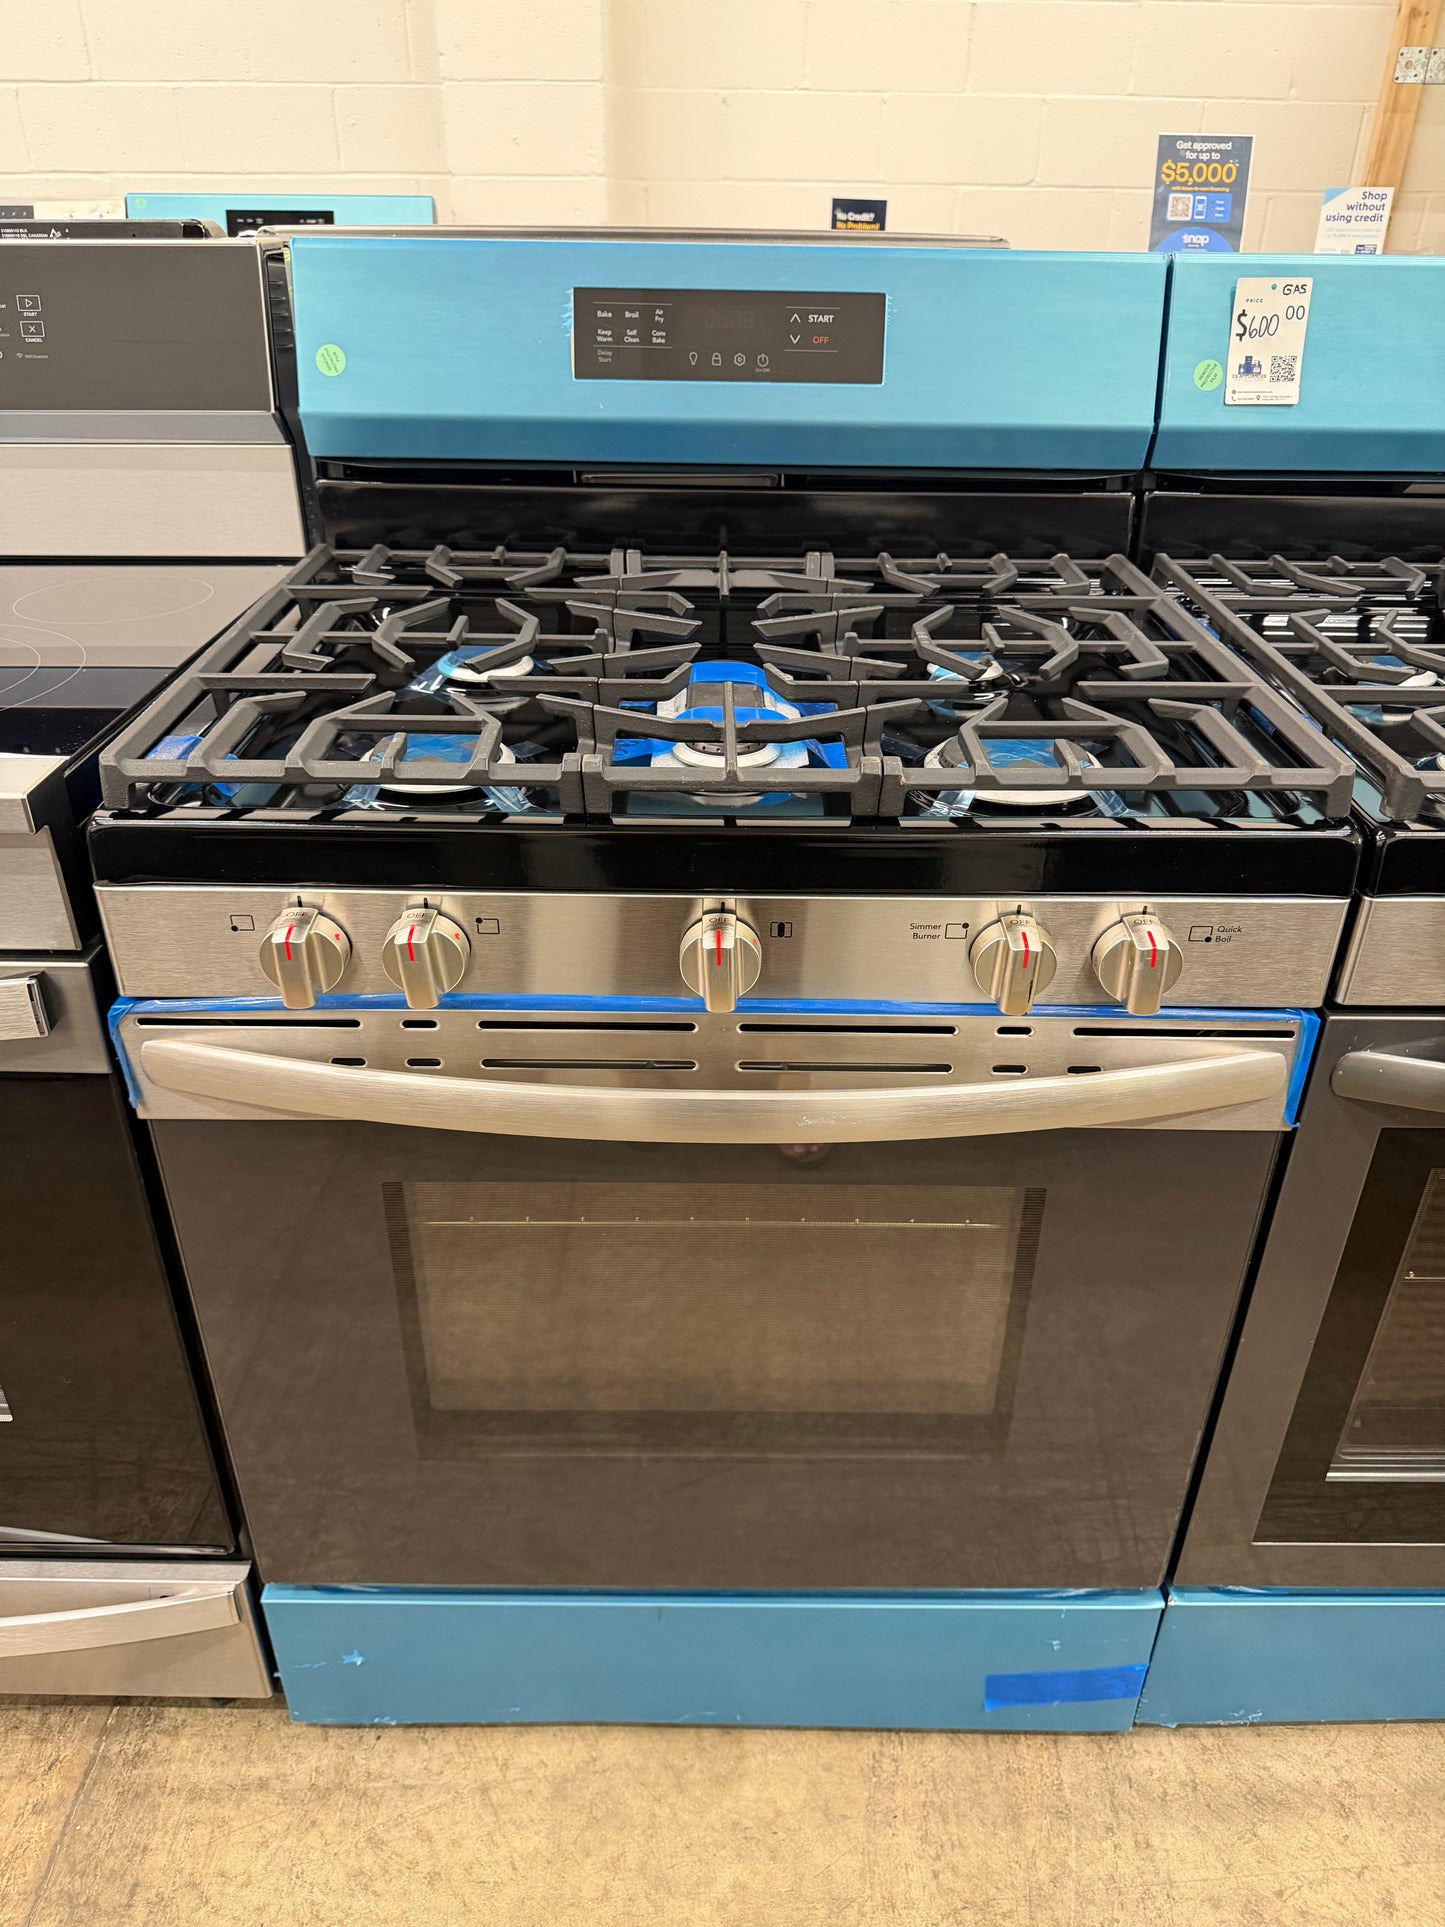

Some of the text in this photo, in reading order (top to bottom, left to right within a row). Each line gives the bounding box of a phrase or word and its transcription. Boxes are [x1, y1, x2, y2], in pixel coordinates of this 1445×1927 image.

[1176, 140, 1232, 152] Get approved
[1185, 151, 1221, 161] for up to
[1161, 159, 1237, 185] $5,000
[1361, 190, 1388, 202] Shop
[1346, 201, 1386, 211] without
[836, 211, 875, 221] No Credit?
[1325, 212, 1384, 224] using credit
[835, 221, 847, 230] No
[1282, 284, 1307, 296] GAS
[597, 310, 613, 318] Bake
[808, 314, 834, 323] START
[654, 315, 664, 324] Fry
[1236, 305, 1305, 342] $600 00
[597, 328, 613, 336] Keep
[651, 329, 667, 337] Conv
[652, 336, 666, 344] Bake
[812, 336, 829, 344] OFF
[597, 349, 613, 357] Delay
[910, 922, 942, 930] Simmer
[1217, 925, 1243, 933] Quick
[912, 932, 941, 940] Burner
[1215, 935, 1232, 943] Boil
